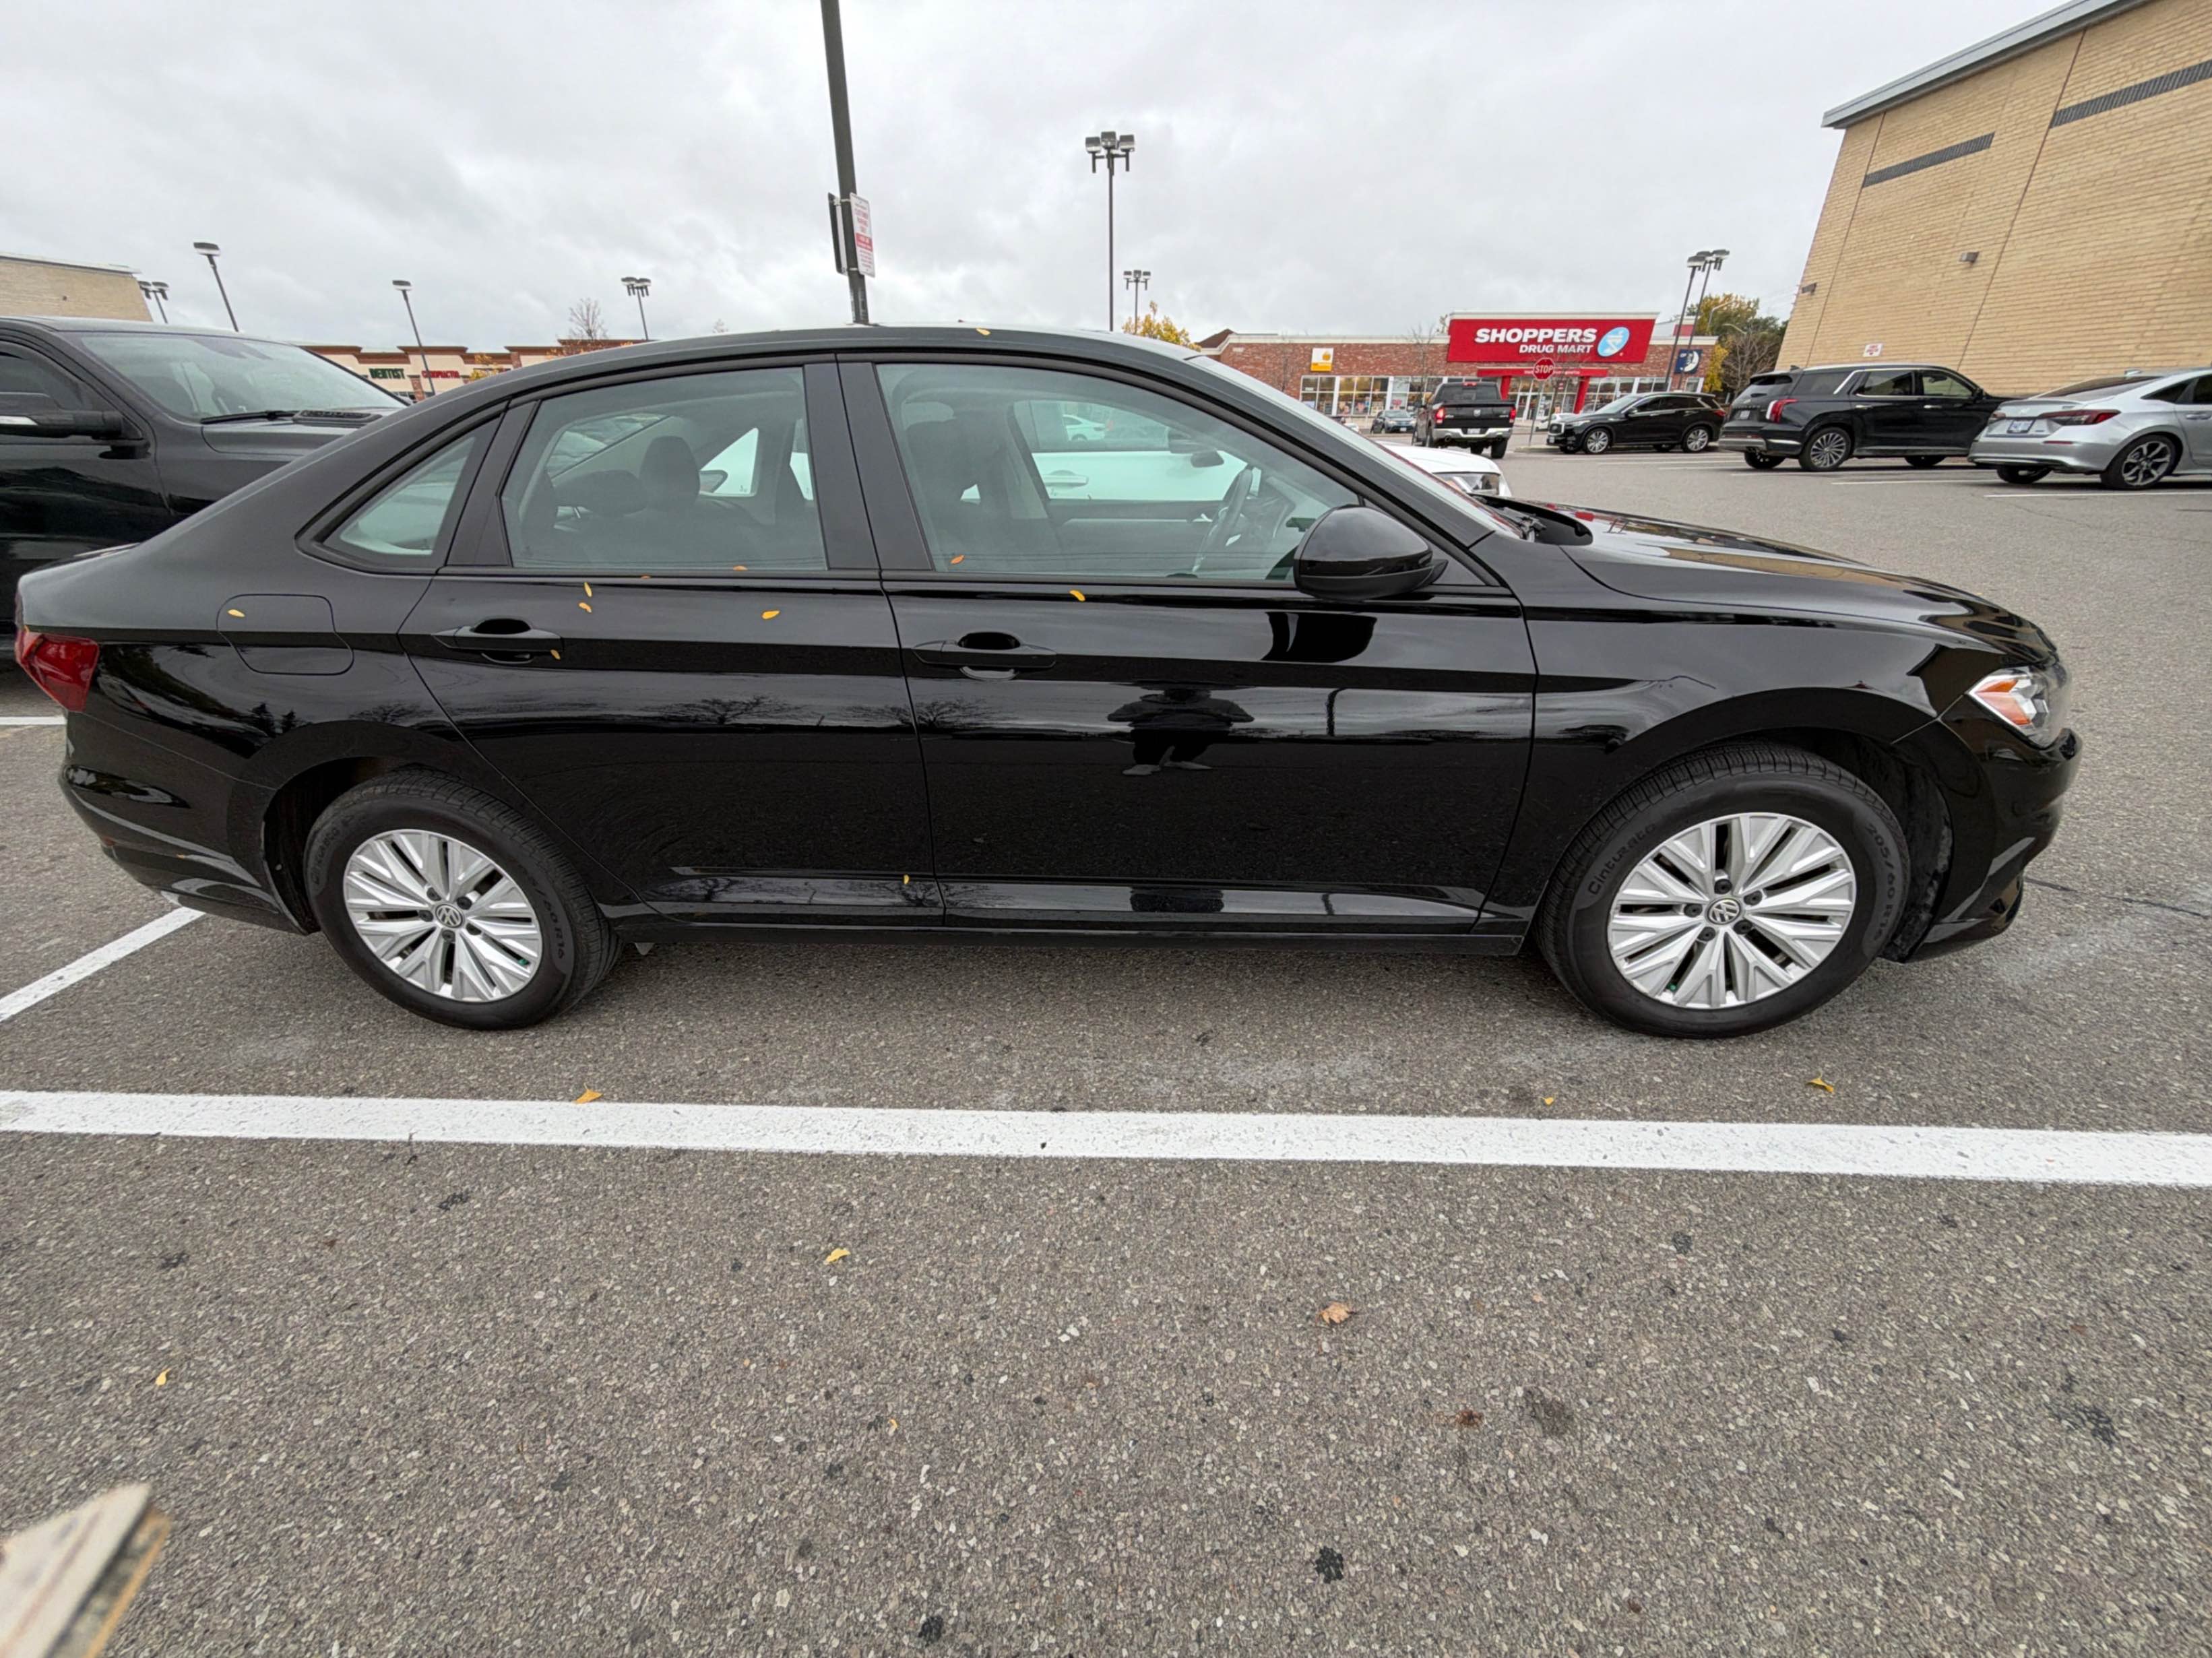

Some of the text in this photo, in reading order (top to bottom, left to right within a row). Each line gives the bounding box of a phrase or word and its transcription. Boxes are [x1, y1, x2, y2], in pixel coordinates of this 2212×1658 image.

[1474, 328, 1598, 343] SHOPPERS
[1519, 344, 1594, 354] DRUG MART
[369, 369, 406, 379] DENTIST
[1535, 365, 1553, 374] STOP
